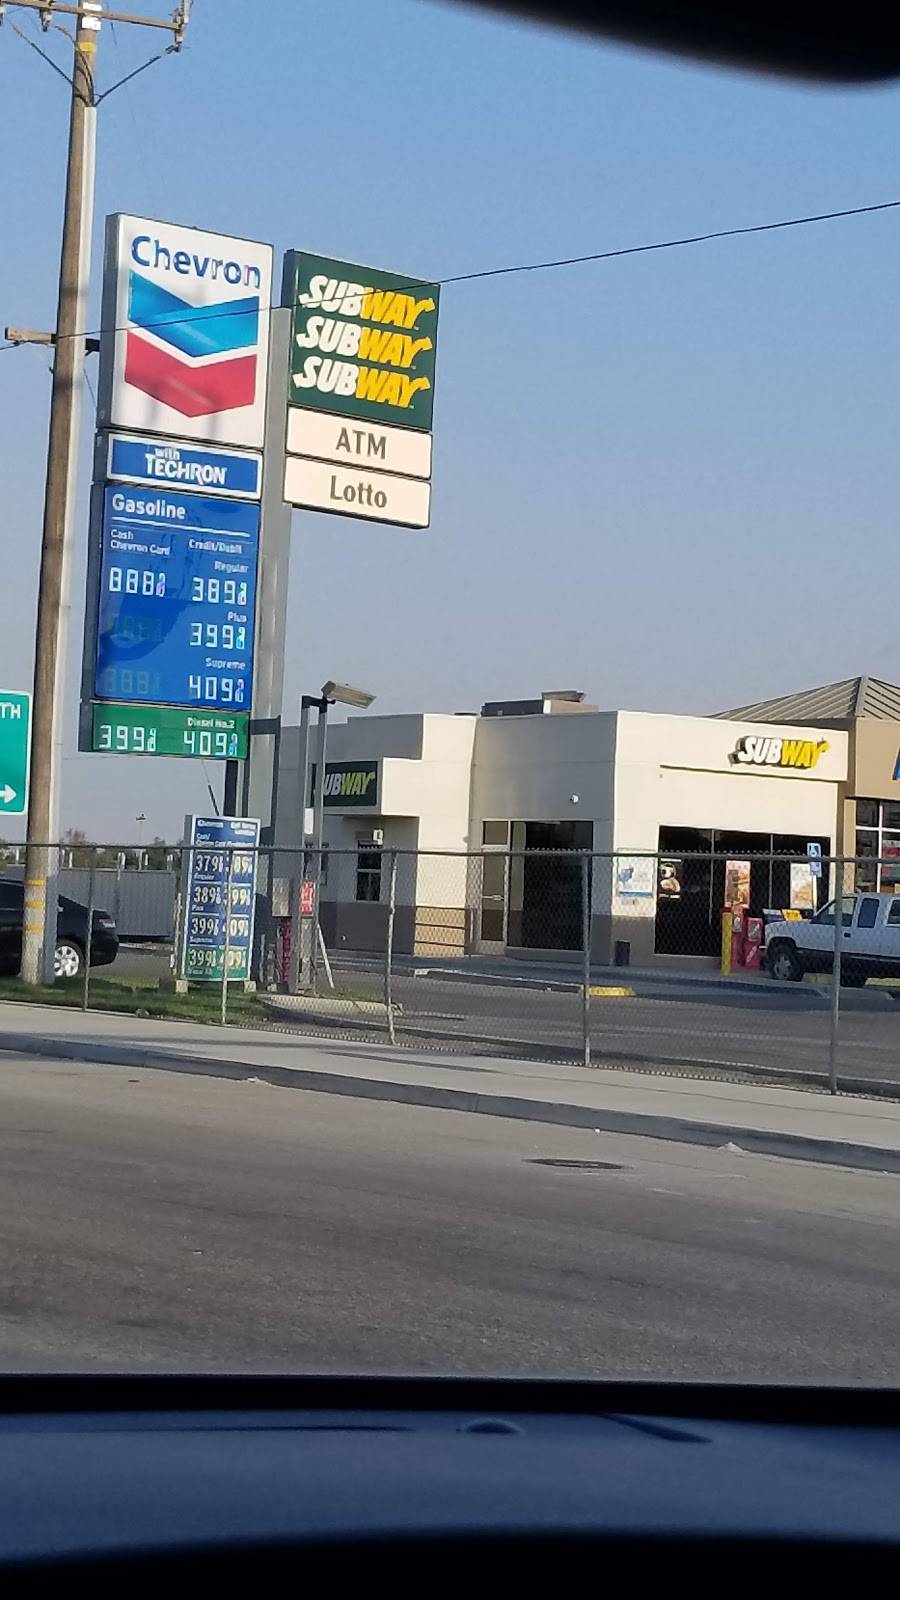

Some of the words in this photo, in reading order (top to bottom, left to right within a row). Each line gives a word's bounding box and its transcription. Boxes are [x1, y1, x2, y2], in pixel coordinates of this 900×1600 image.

[131, 235, 261, 290] Chevron
[298, 275, 436, 330] SUBWAY
[296, 315, 432, 368] SUBWAY
[293, 355, 430, 408] SUBWAY
[155, 448, 180, 460] with
[335, 427, 387, 460] ATM
[145, 453, 227, 485] TECHRON
[112, 493, 186, 519] Gasoline
[330, 475, 387, 508] Lotto
[110, 529, 134, 540] Cash
[110, 540, 148, 553] Chevron
[149, 544, 170, 556] Card
[214, 560, 249, 574] Regular
[227, 611, 247, 623] Plus
[205, 657, 246, 671] Supreme
[733, 735, 830, 769] SUBWAY
[323, 771, 376, 796] UBWAY
